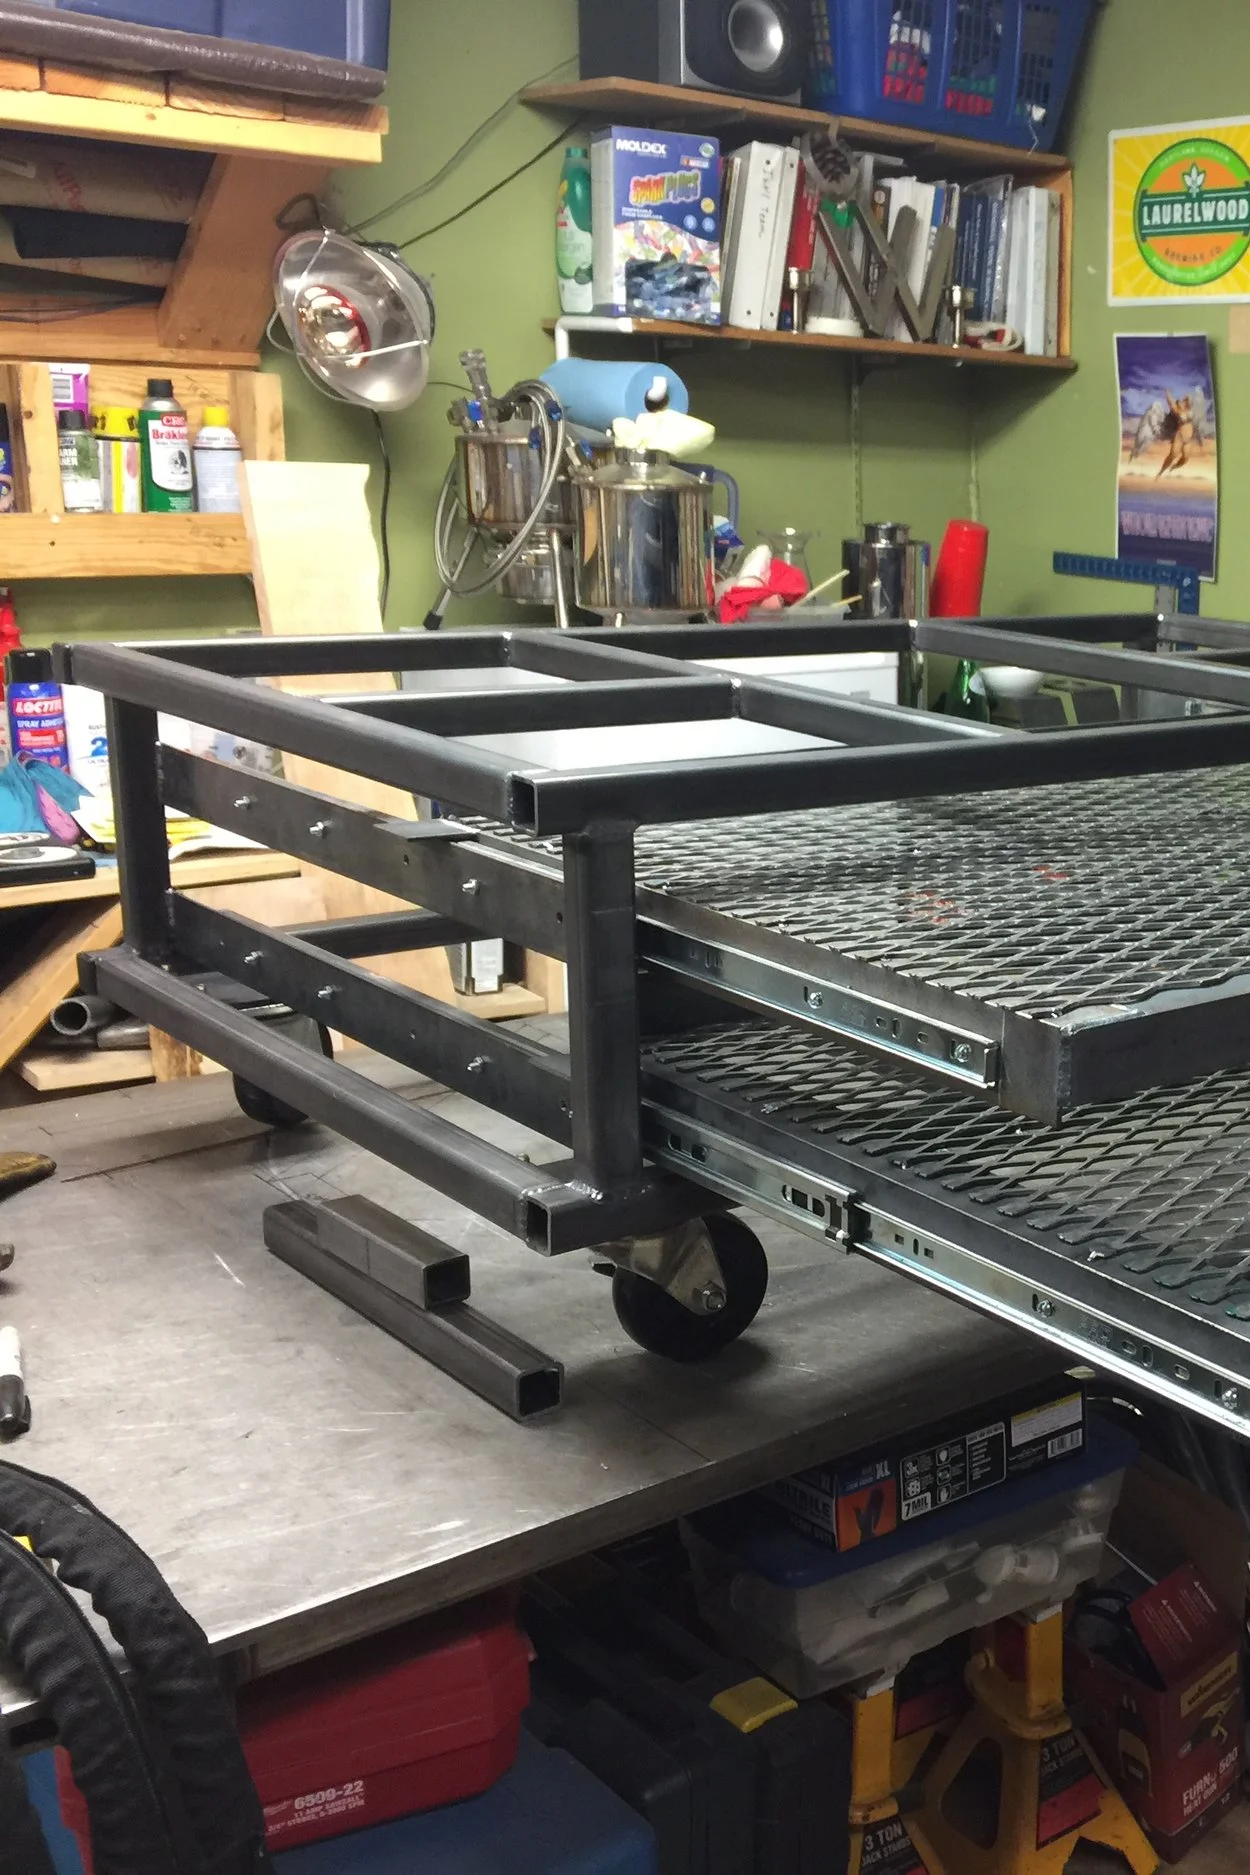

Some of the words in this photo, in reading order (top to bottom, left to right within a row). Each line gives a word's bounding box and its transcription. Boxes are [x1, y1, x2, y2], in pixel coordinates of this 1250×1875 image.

[616, 139, 667, 154] MOLDEX
[1142, 199, 1250, 226] LAURELWOOD
[903, 1501, 912, 1518] 7
[911, 1498, 930, 1513] MIL
[1043, 1746, 1051, 1762] 3
[1052, 1731, 1077, 1755] TON
[864, 1834, 875, 1852] 3
[876, 1822, 903, 1845] TON
[861, 1851, 882, 1868] JACK
[882, 1837, 912, 1862] STANDS
